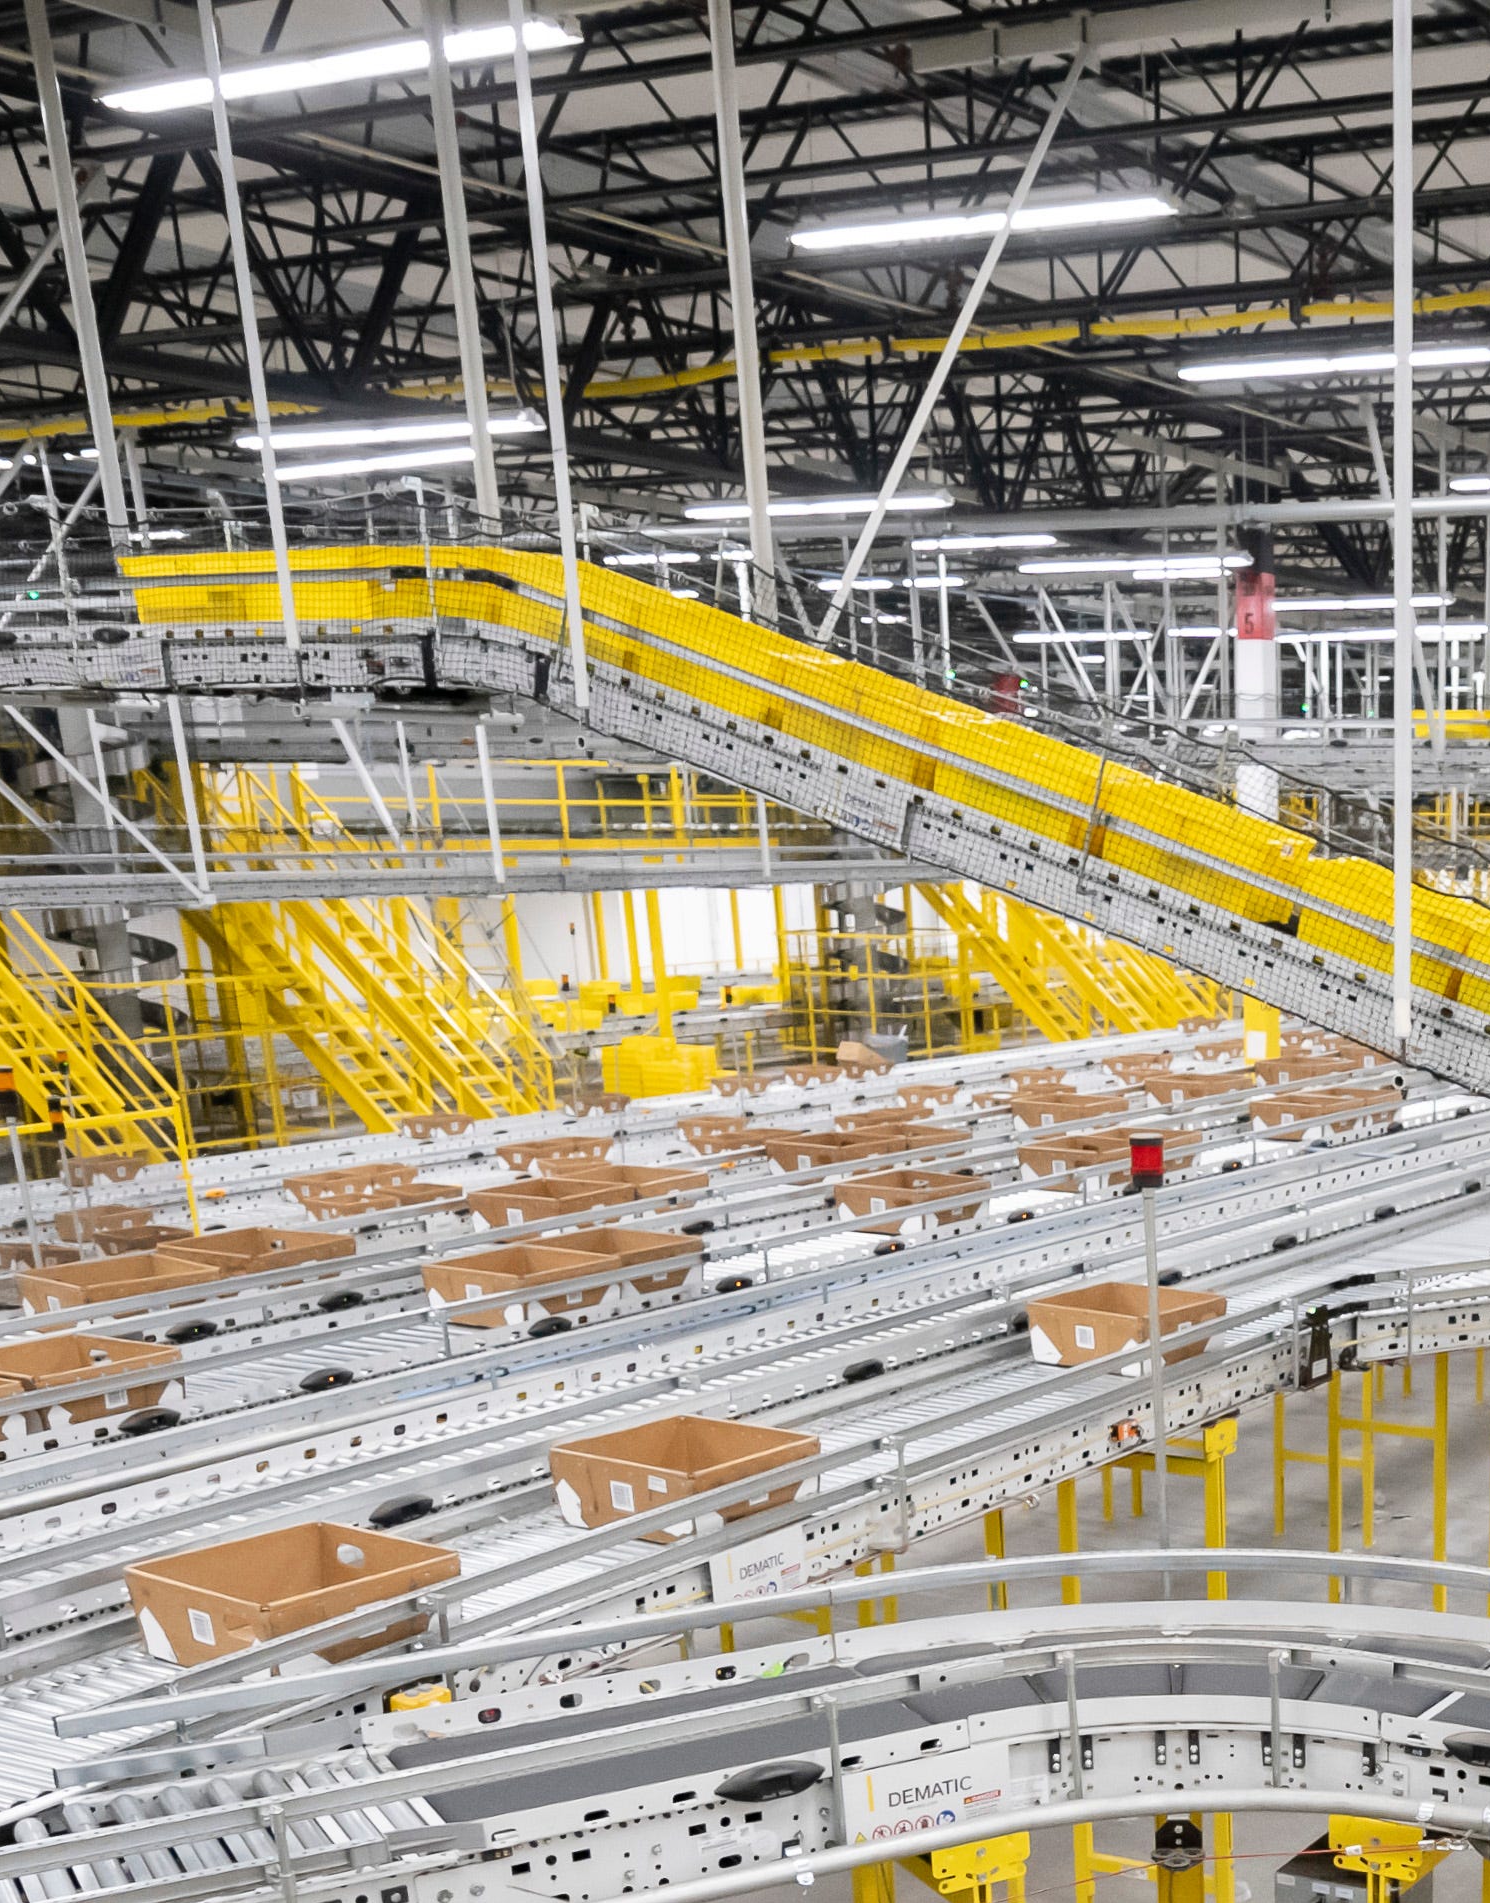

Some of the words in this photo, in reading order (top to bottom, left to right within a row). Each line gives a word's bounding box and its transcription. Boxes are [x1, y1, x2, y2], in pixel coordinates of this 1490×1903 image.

[1244, 612, 1255, 635] 5
[739, 1552, 785, 1581] DEMATIC
[888, 1775, 973, 1808] DEMATIC
